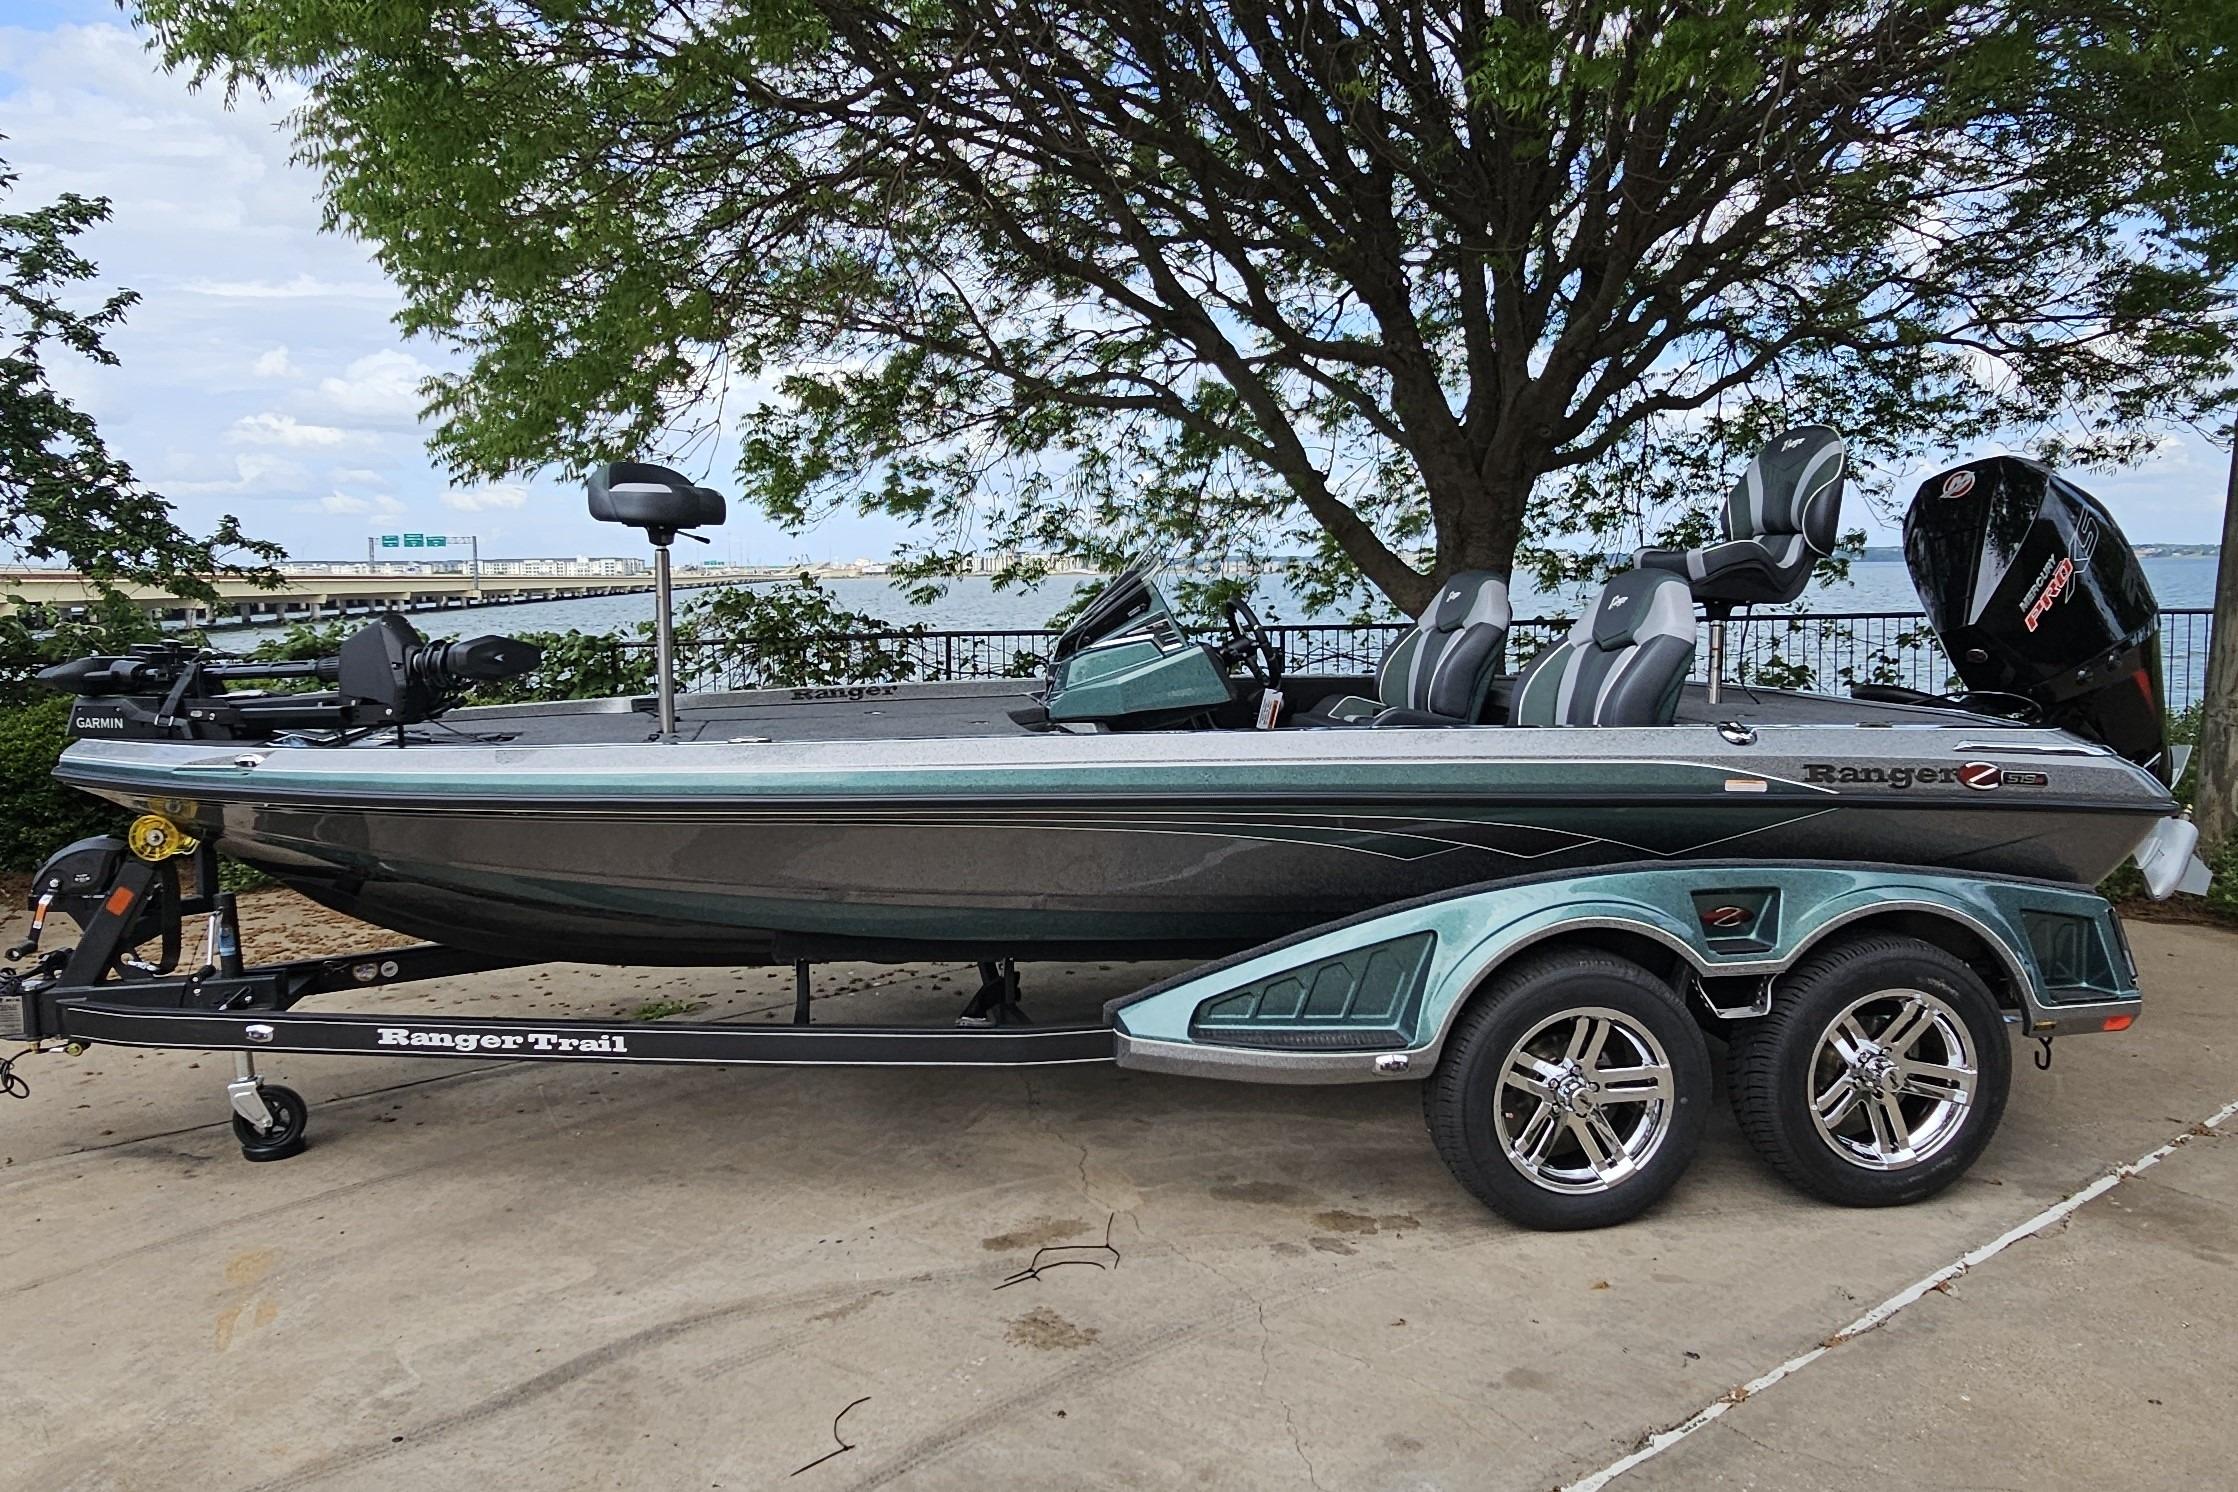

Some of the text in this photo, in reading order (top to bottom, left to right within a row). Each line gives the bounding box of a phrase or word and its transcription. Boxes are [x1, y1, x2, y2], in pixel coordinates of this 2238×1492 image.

[2019, 553, 2056, 612] MERCURY
[2025, 558, 2073, 632] PRO
[789, 686, 898, 700] Ranger
[76, 717, 123, 729] GARMIN
[1803, 763, 1958, 789] Ranger
[377, 1028, 627, 1052] Ranger Trail
